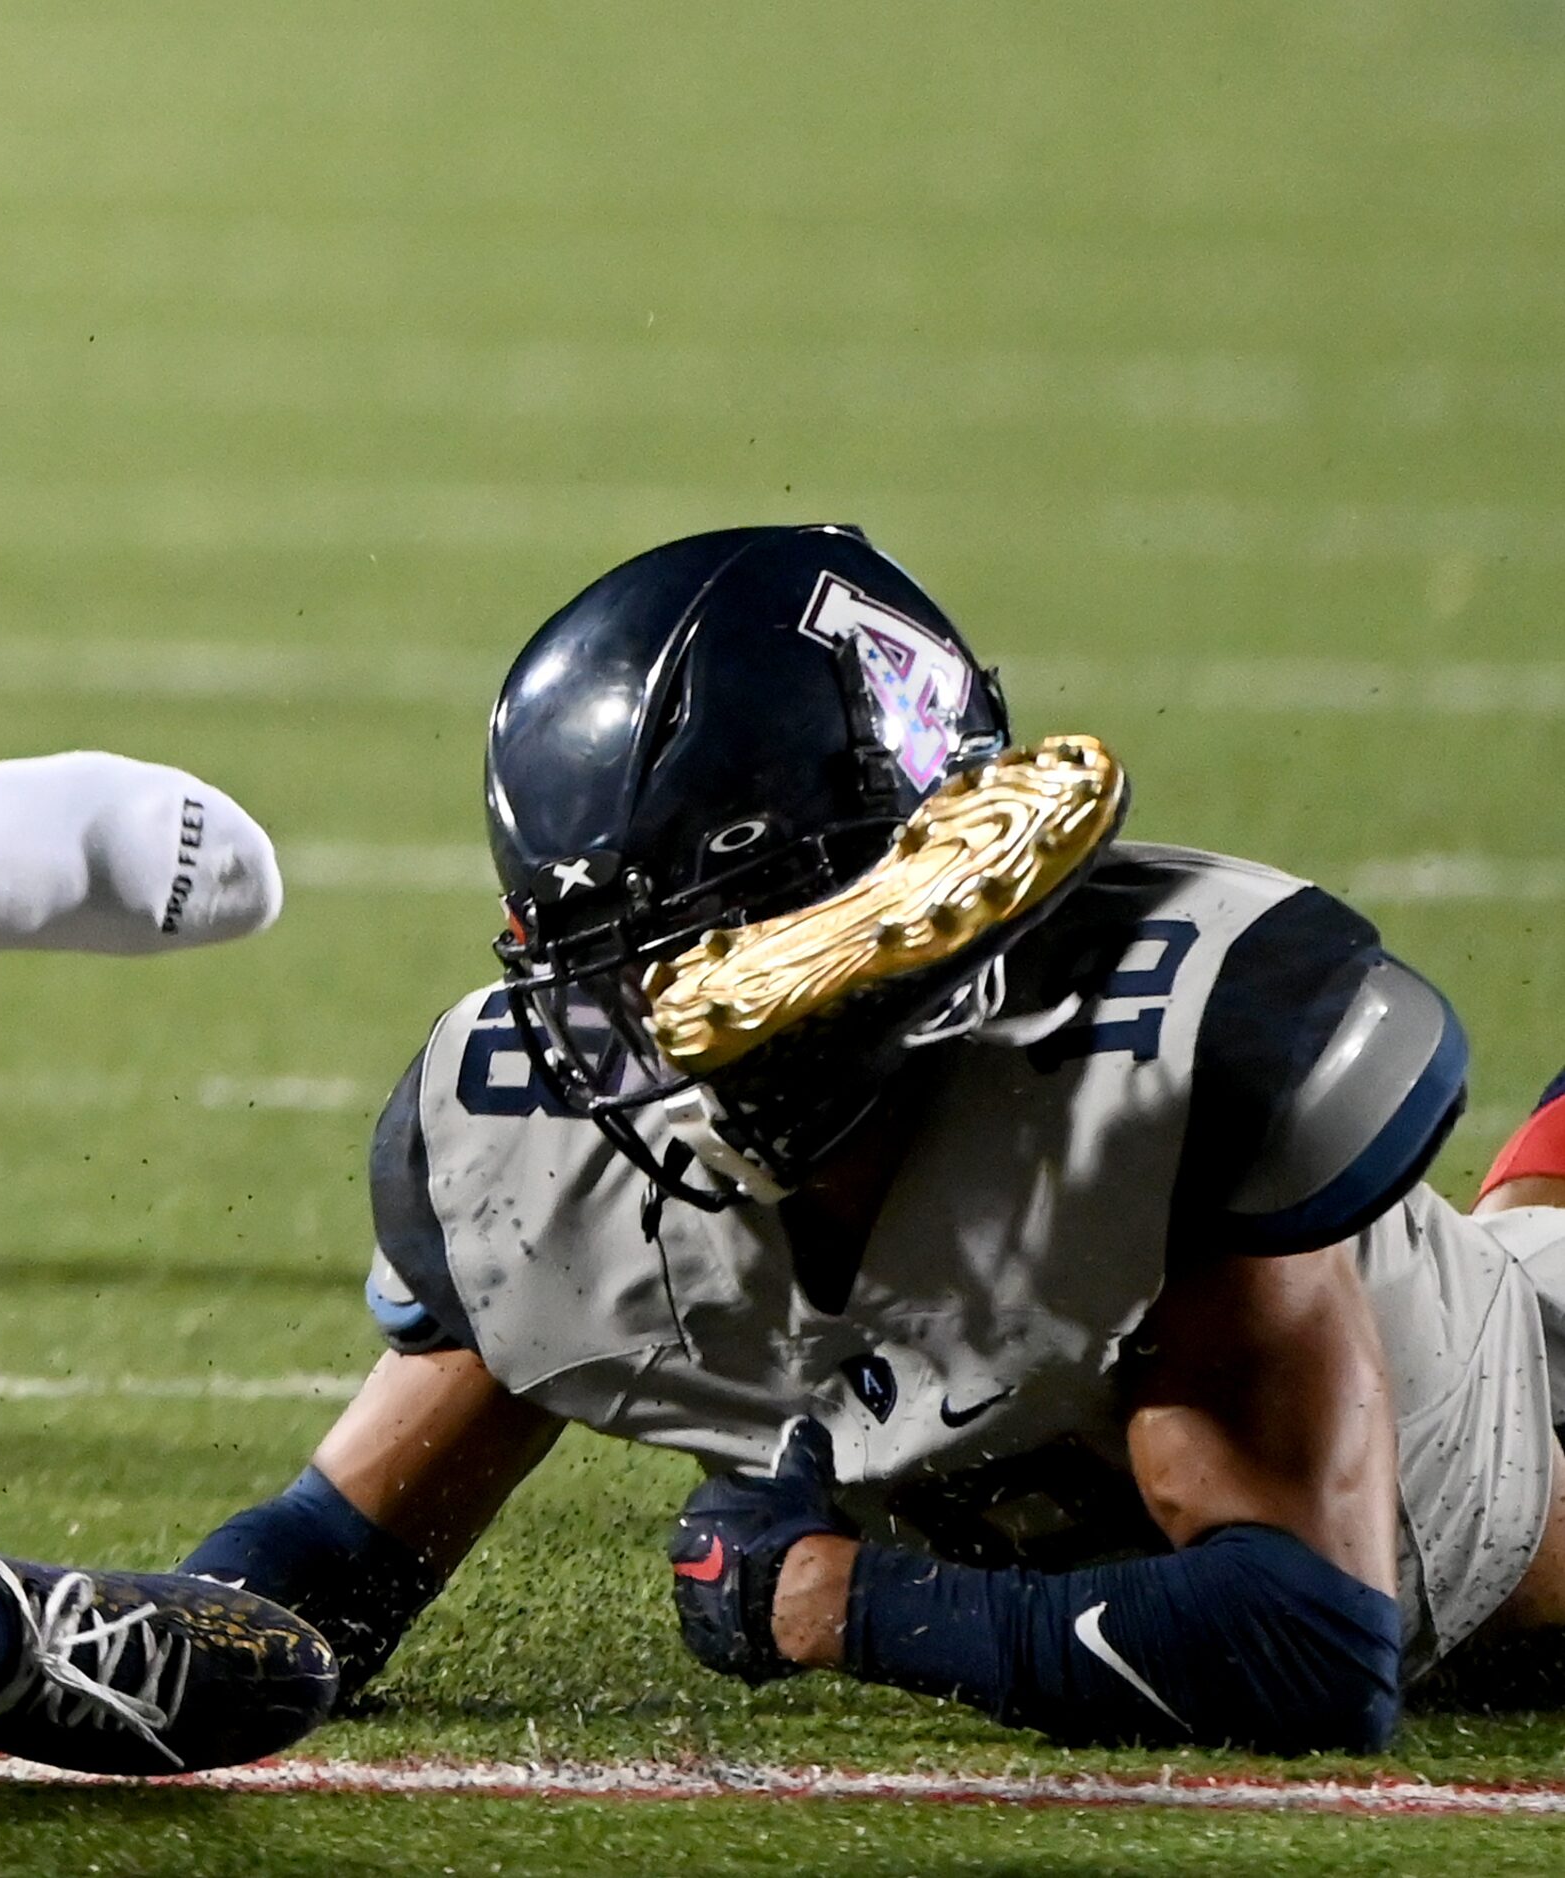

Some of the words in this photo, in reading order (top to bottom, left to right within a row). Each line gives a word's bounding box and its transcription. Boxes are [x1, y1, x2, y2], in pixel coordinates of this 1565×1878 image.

[799, 570, 973, 793] A
[163, 875, 192, 933] PRO
[179, 797, 204, 866] FEET
[860, 1367, 884, 1396] A
